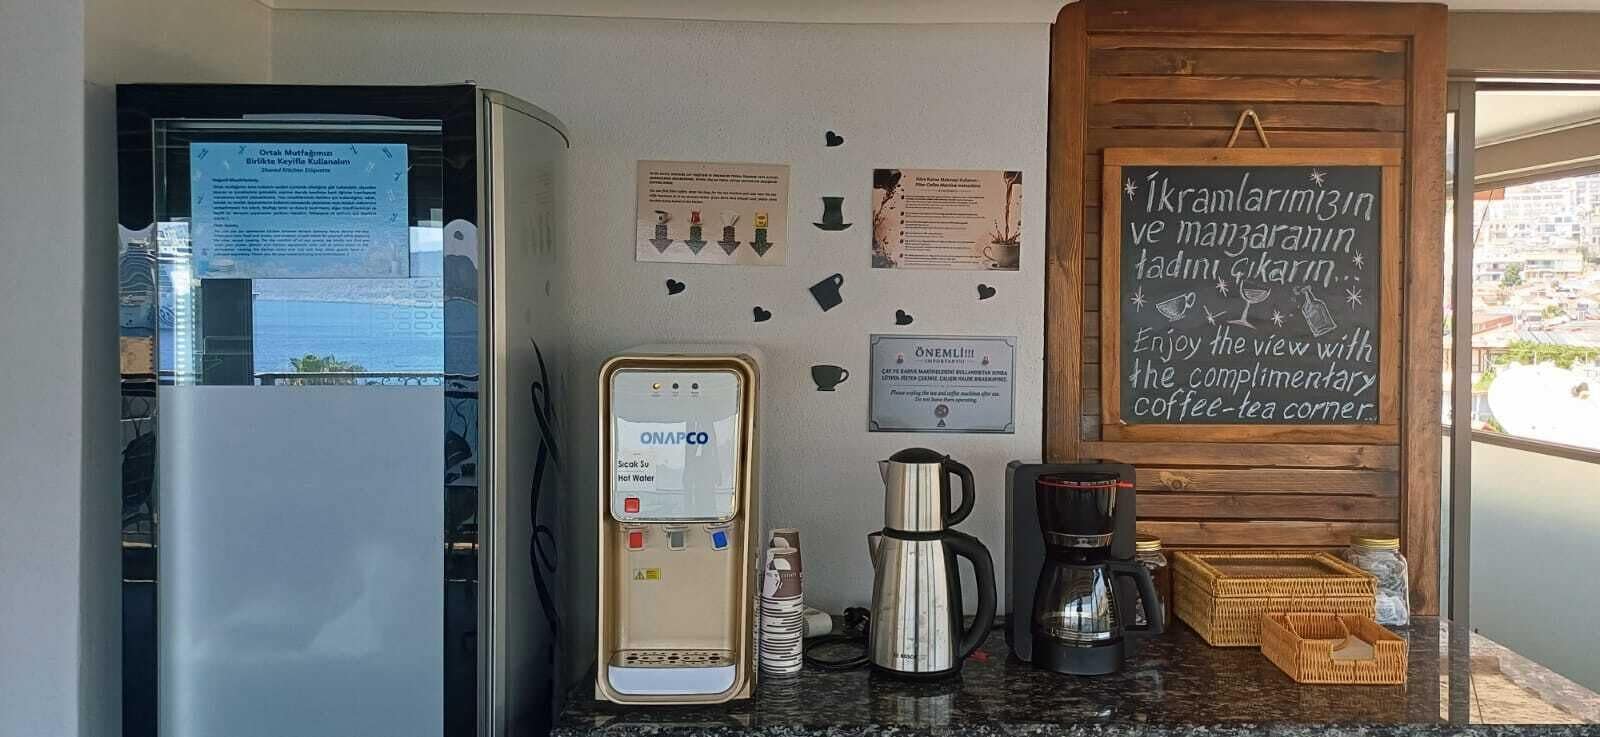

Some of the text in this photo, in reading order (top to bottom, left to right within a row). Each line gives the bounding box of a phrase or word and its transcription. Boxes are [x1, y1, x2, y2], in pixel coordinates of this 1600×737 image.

[259, 149, 282, 157] Ortak
[1130, 219, 1356, 258] ve manzaranın
[1134, 248, 1220, 281] tadını
[1132, 324, 1376, 363] Enjoy the view with
[915, 346, 975, 358] ÖNEMLİ!!!
[1129, 358, 1377, 397] the complimentary
[640, 432, 709, 445] ONAPCO
[640, 460, 650, 469] Su
[617, 474, 655, 482] Hot Water
